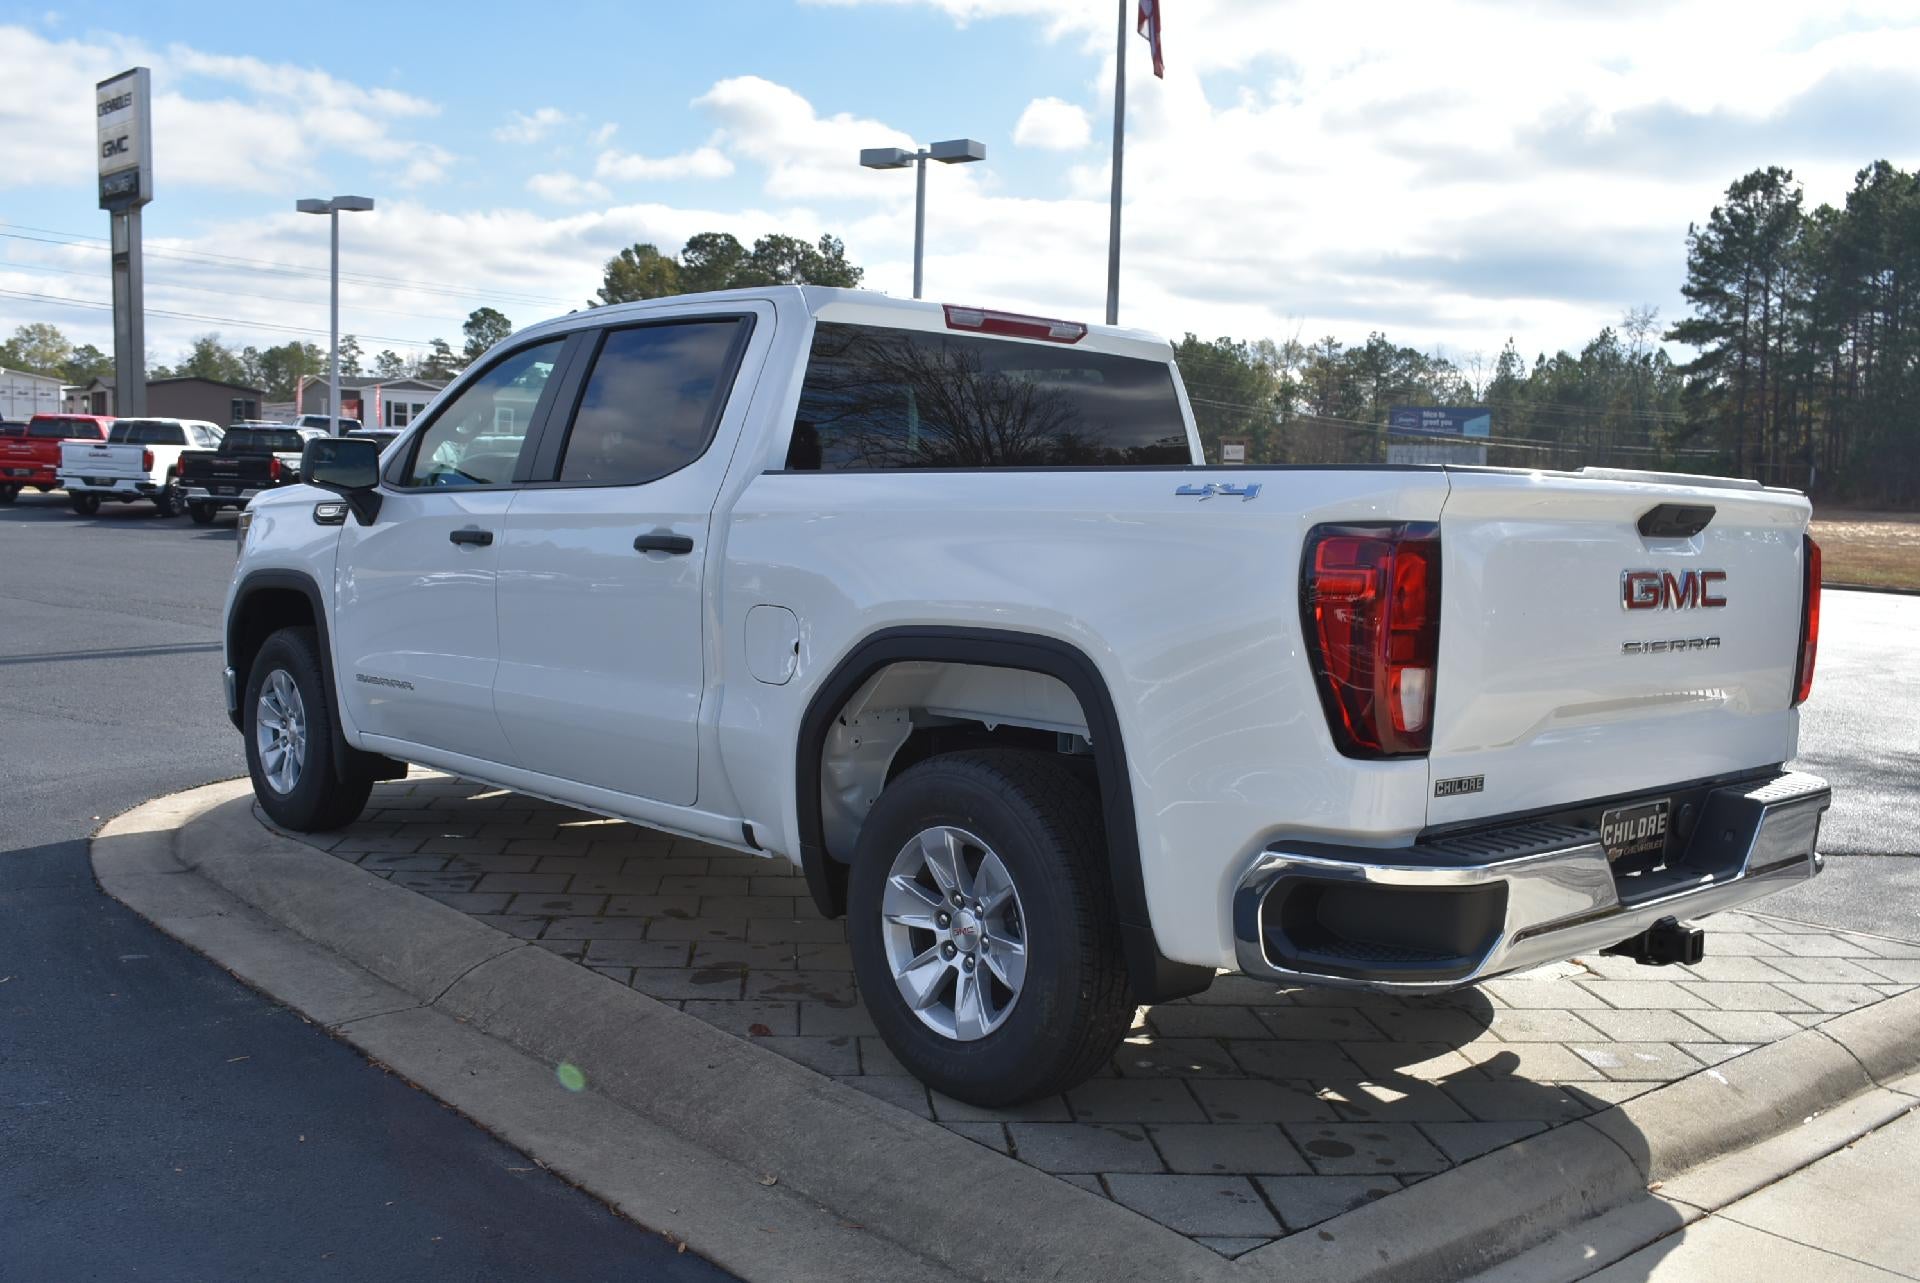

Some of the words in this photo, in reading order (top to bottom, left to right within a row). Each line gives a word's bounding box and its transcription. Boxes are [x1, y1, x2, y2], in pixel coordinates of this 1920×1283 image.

[102, 135, 129, 158] GMC
[1438, 410, 1446, 418] to
[1440, 419, 1453, 427] you
[1620, 568, 1727, 611] GMC
[1622, 637, 1721, 655] SIERRA
[1436, 777, 1483, 795] CHILDRE
[1603, 812, 1667, 846] CHILDRE
